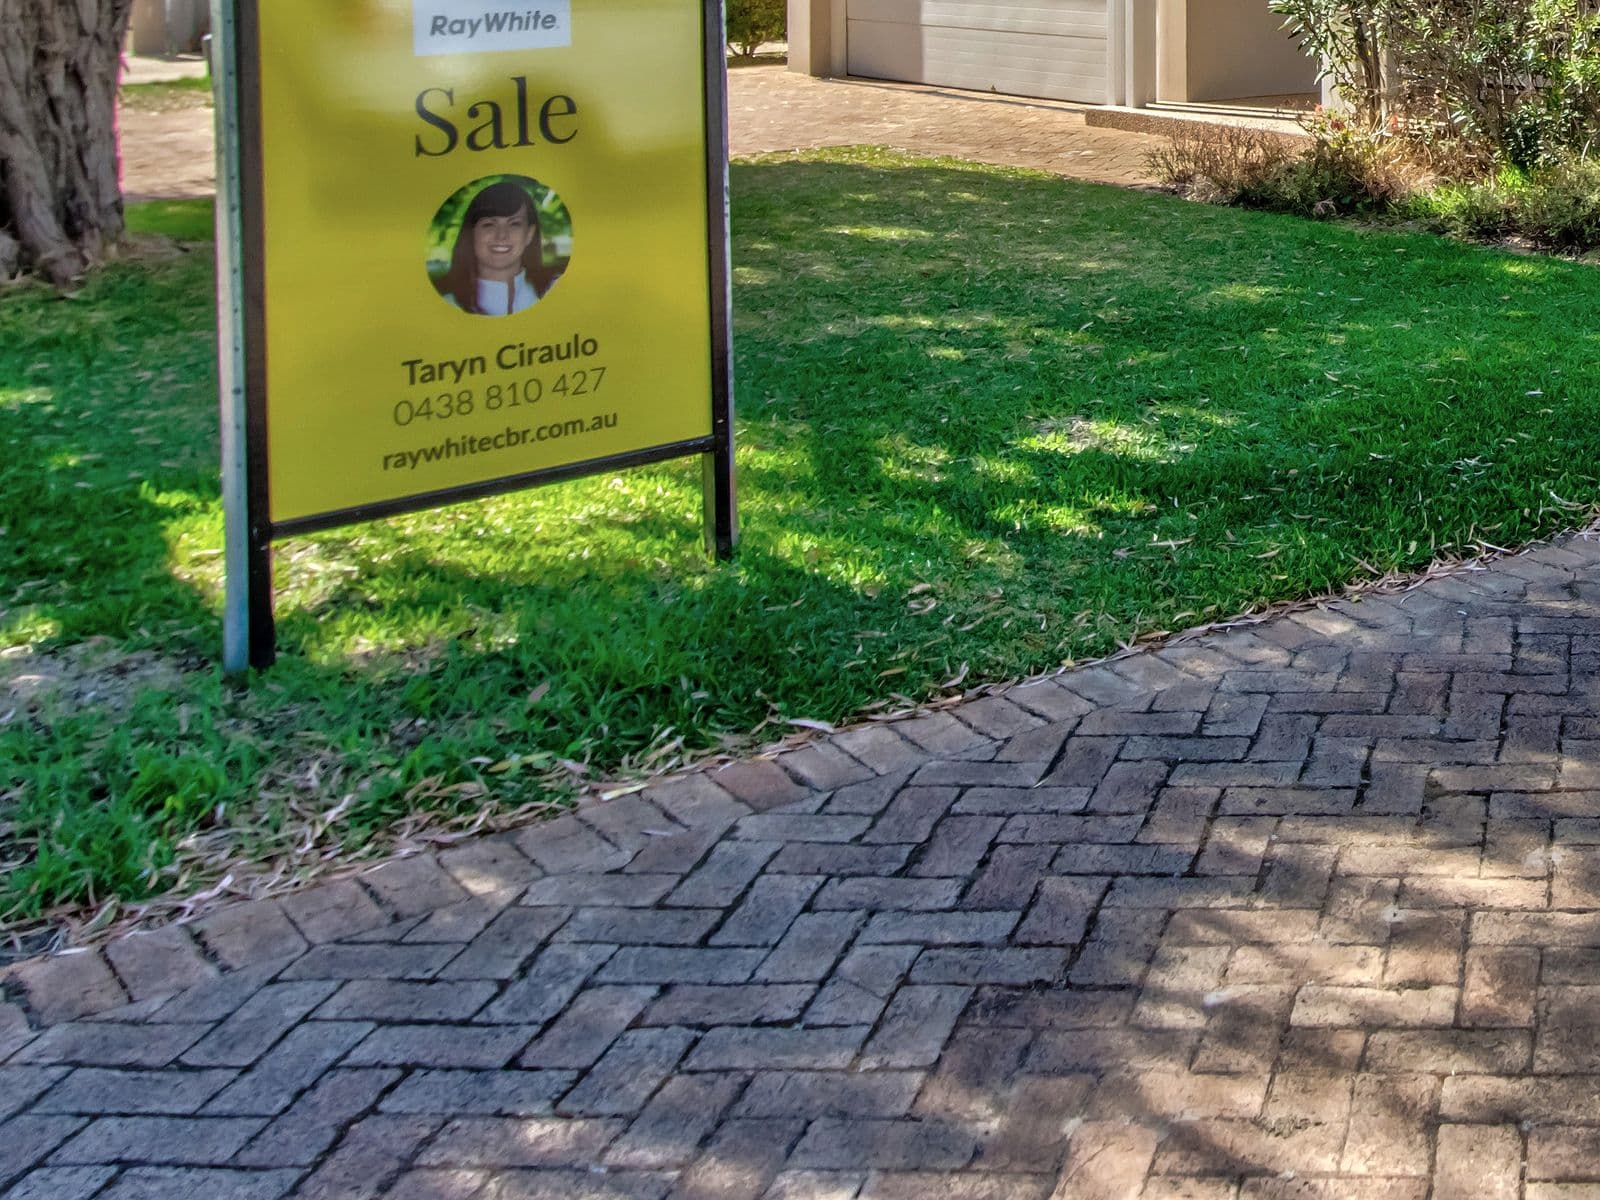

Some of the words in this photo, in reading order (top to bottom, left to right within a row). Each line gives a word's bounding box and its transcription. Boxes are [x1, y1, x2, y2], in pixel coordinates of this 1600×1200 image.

[414, 76, 579, 158] Sale
[402, 354, 486, 385] Taryn
[496, 333, 598, 370] Ciraulo
[393, 389, 475, 426] 0438
[485, 378, 543, 411] 810
[551, 366, 607, 398] 427
[383, 412, 618, 471] raywhitecbr.com.au
